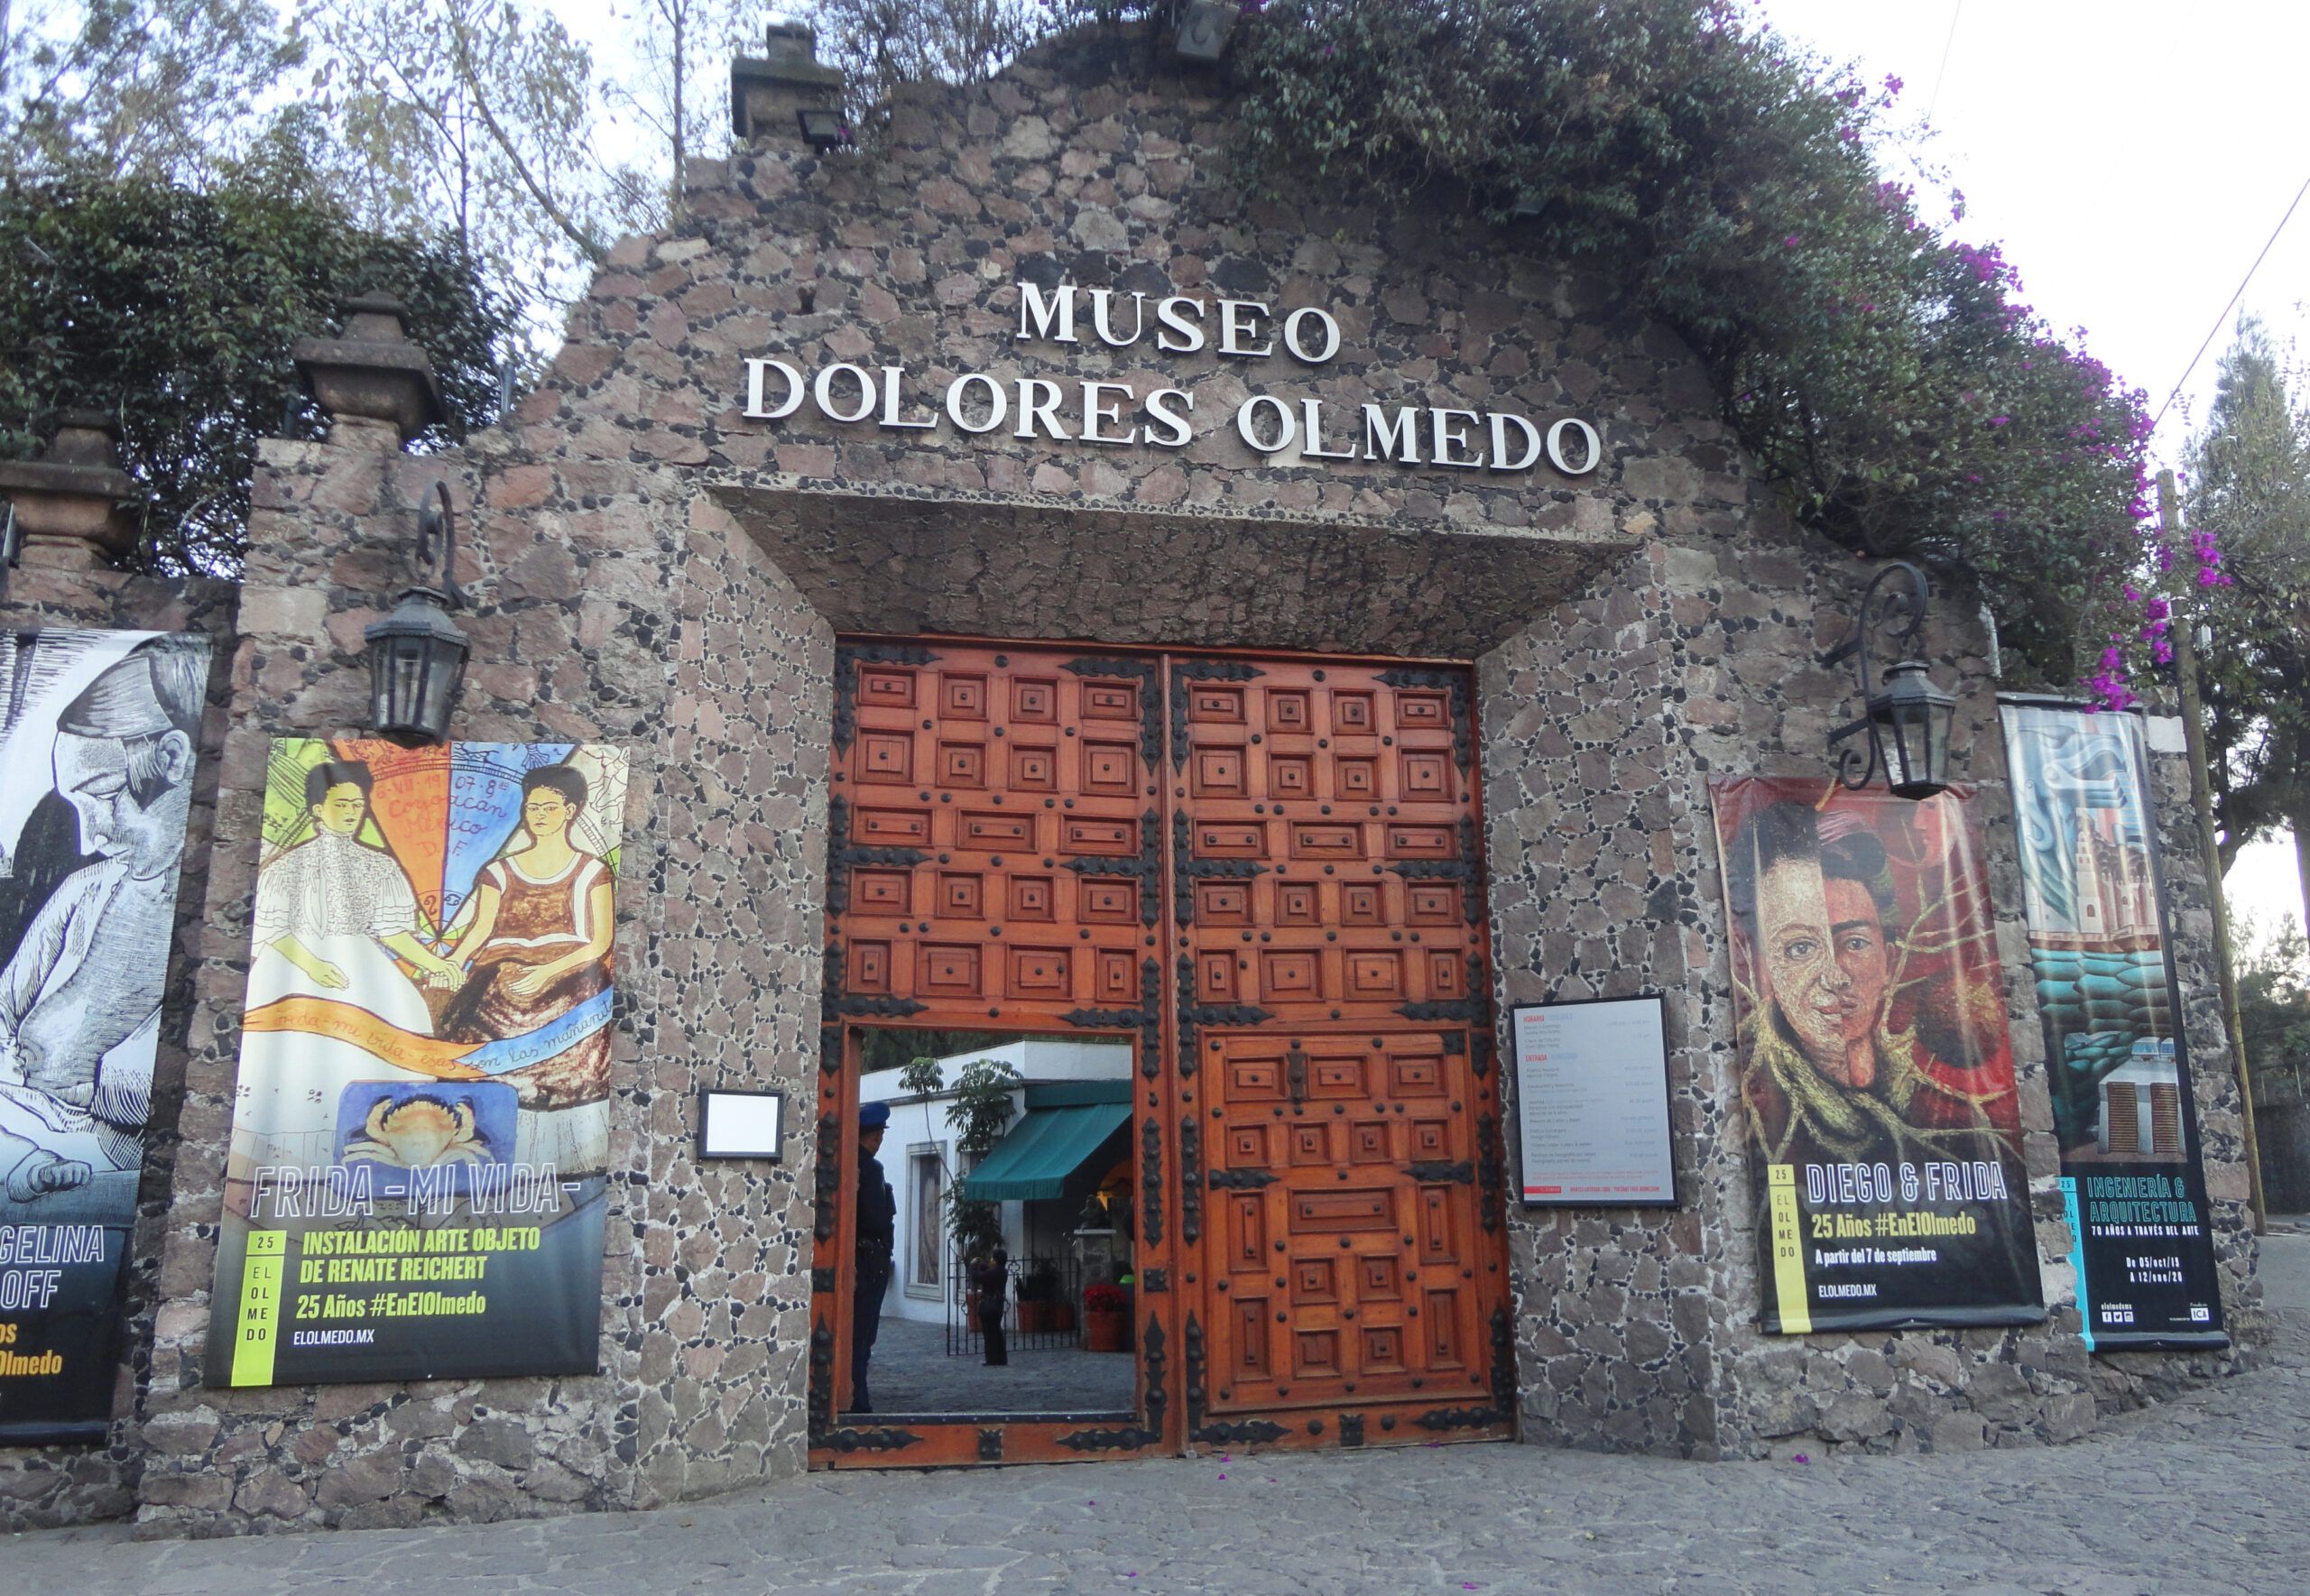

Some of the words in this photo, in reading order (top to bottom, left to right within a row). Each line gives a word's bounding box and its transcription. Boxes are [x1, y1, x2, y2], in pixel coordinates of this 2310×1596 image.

[1016, 281, 1341, 363] MUSEO
[742, 357, 1195, 447] DOLORES
[1237, 394, 1602, 475] OLMEDO
[1776, 1169, 1787, 1180] 25
[1806, 1163, 1892, 1204] DIEGO
[1900, 1162, 1919, 1202] &
[1927, 1161, 2009, 1201] FRIDA
[2087, 1174, 2172, 1198] INGENIERÍA
[250, 1165, 374, 1218] FRIDA
[1812, 1213, 1834, 1238] 25
[1836, 1213, 1872, 1238] Años
[1874, 1211, 1976, 1237] #EnElOlmedo
[2090, 1201, 2197, 1224] ARQUITECTURA
[257, 1236, 274, 1249] 25
[302, 1226, 420, 1256] INSTALACIÓN
[423, 1228, 469, 1253] ARTE
[472, 1226, 541, 1251] OBJETO
[2092, 1225, 2102, 1236] 70
[2105, 1223, 2125, 1236] AÑOS
[2127, 1225, 2132, 1236] A
[2134, 1223, 2164, 1236] TRAVÉS
[0, 1224, 105, 1264] GELINA
[1816, 1249, 1824, 1265] A
[1825, 1248, 1850, 1267] partir
[1851, 1248, 1865, 1264] del
[1866, 1248, 1872, 1263] 7
[1874, 1247, 1885, 1263] de
[1886, 1246, 1937, 1266] septiembre
[300, 1259, 326, 1284] DE
[328, 1257, 394, 1283] RENATE
[396, 1255, 488, 1281] REICHERT
[1, 1269, 62, 1309] OFF
[1818, 1283, 1878, 1298] ELOLMEDO.MX
[296, 1295, 320, 1319] 25
[322, 1293, 366, 1319] Años
[369, 1290, 486, 1317] #EnElOlmedo
[293, 1328, 375, 1345] ELOLMEDO.MX
